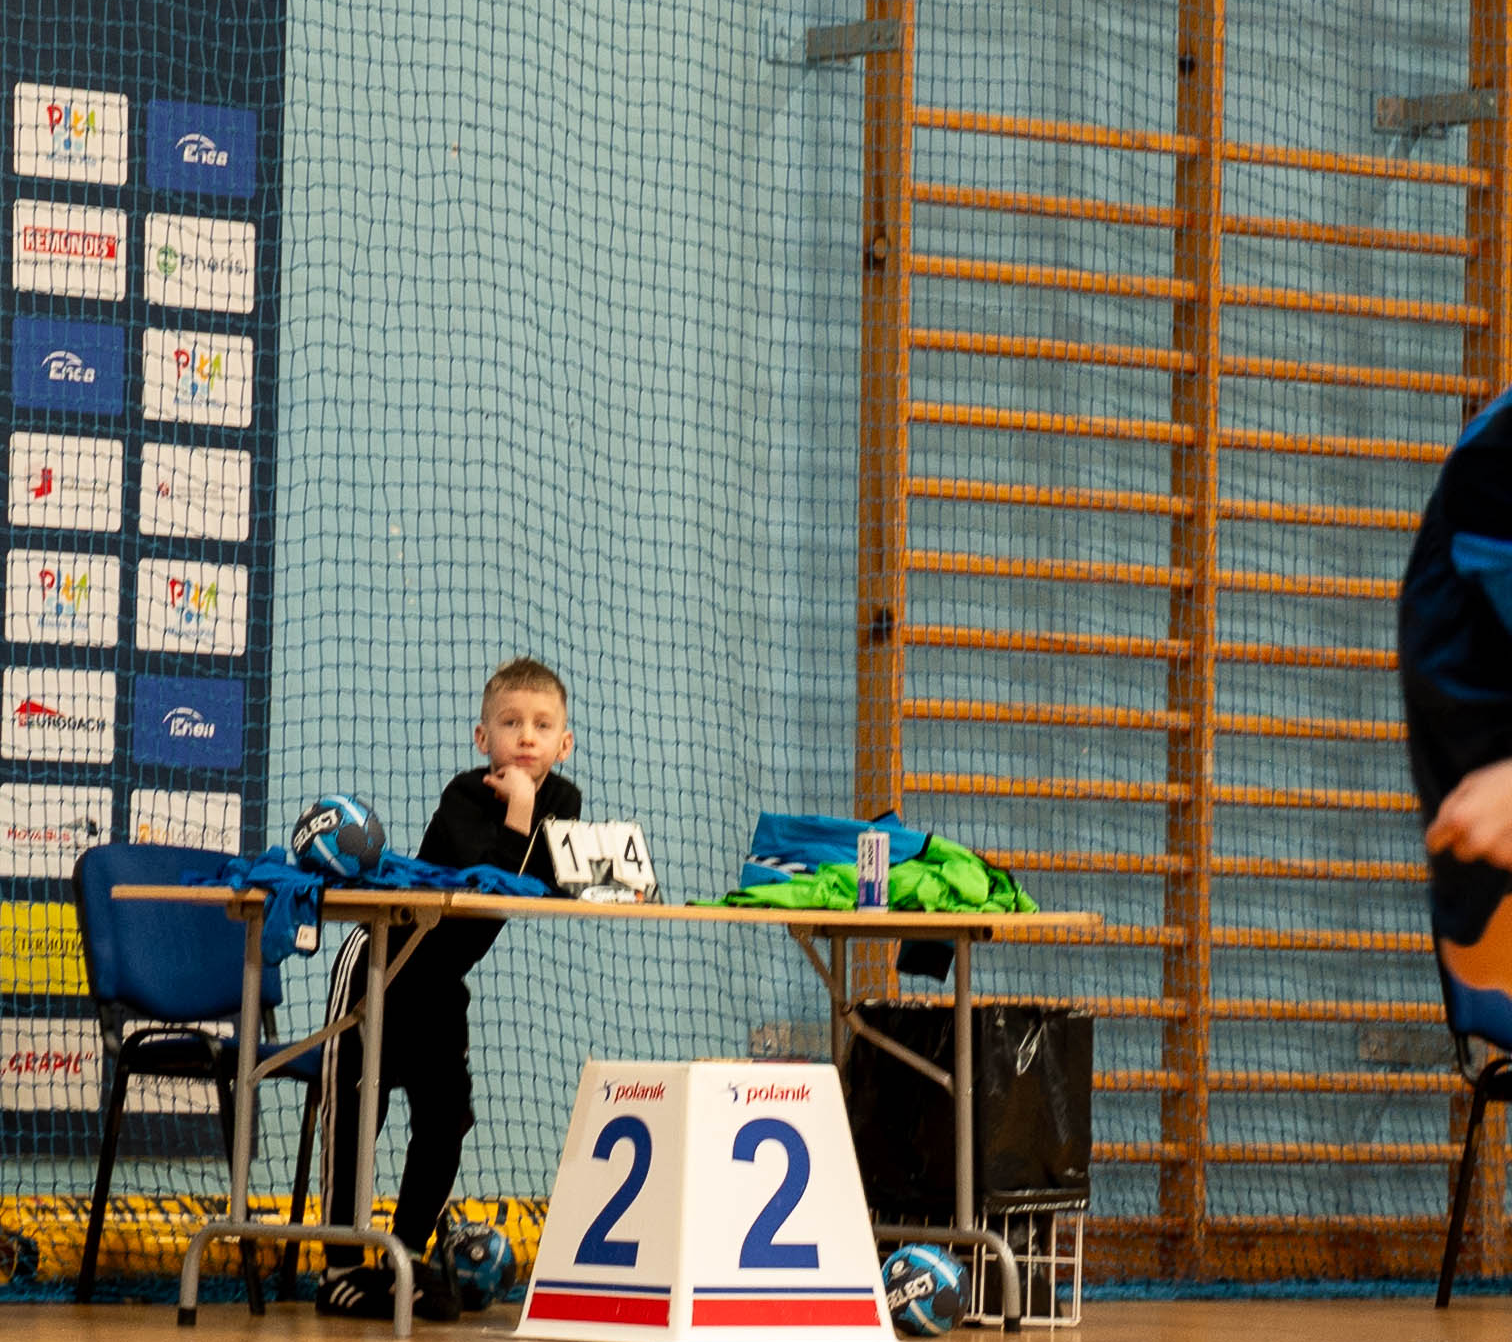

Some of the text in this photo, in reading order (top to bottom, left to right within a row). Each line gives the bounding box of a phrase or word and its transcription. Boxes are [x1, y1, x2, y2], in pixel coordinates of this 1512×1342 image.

[293, 807, 340, 853] SELECT
[561, 832, 579, 873] 1
[623, 835, 643, 874] 4
[613, 1081, 666, 1105] polanik
[746, 1082, 811, 1106] polanik
[573, 1115, 653, 1268] 2
[731, 1117, 820, 1270] 2
